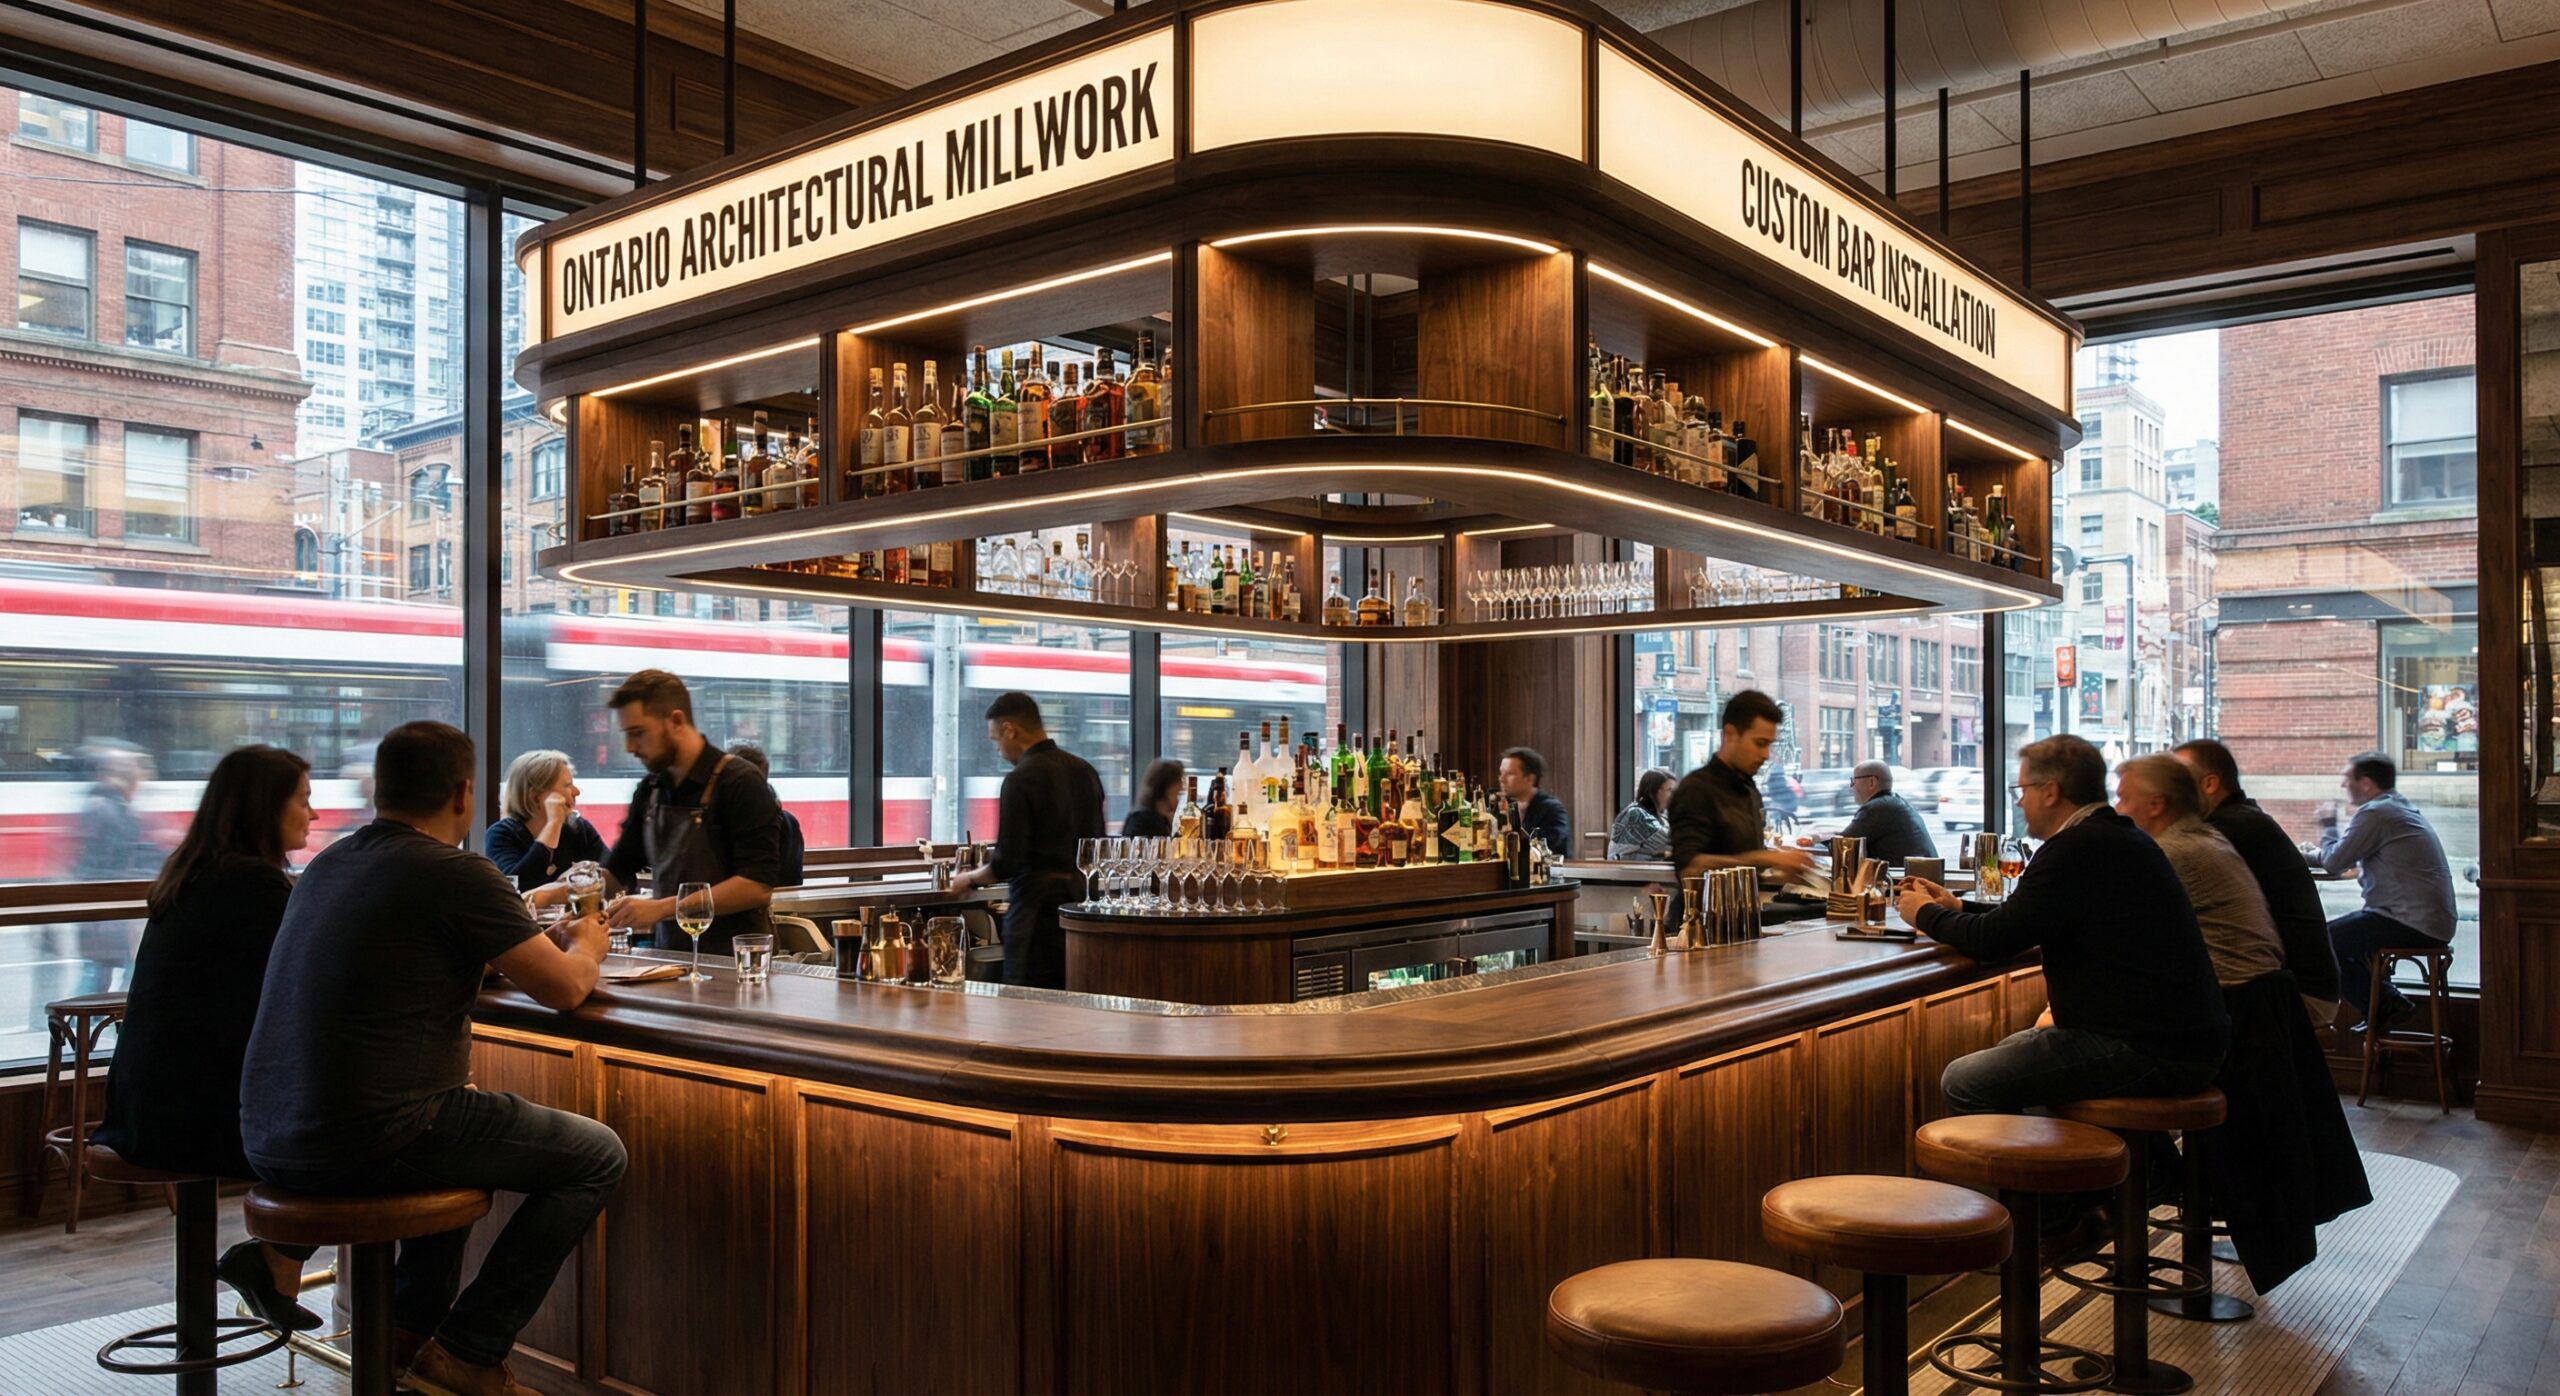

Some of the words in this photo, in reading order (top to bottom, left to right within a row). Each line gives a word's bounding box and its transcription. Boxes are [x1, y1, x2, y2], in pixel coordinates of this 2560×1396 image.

[563, 226, 670, 315] ONTARIO
[680, 140, 933, 281] ARCHITECTURAL
[945, 62, 1159, 200] MILLWORK
[1742, 158, 1830, 270] CUSTOM
[1838, 214, 1876, 295] BAR
[1882, 240, 1996, 359] INSTALLATION
